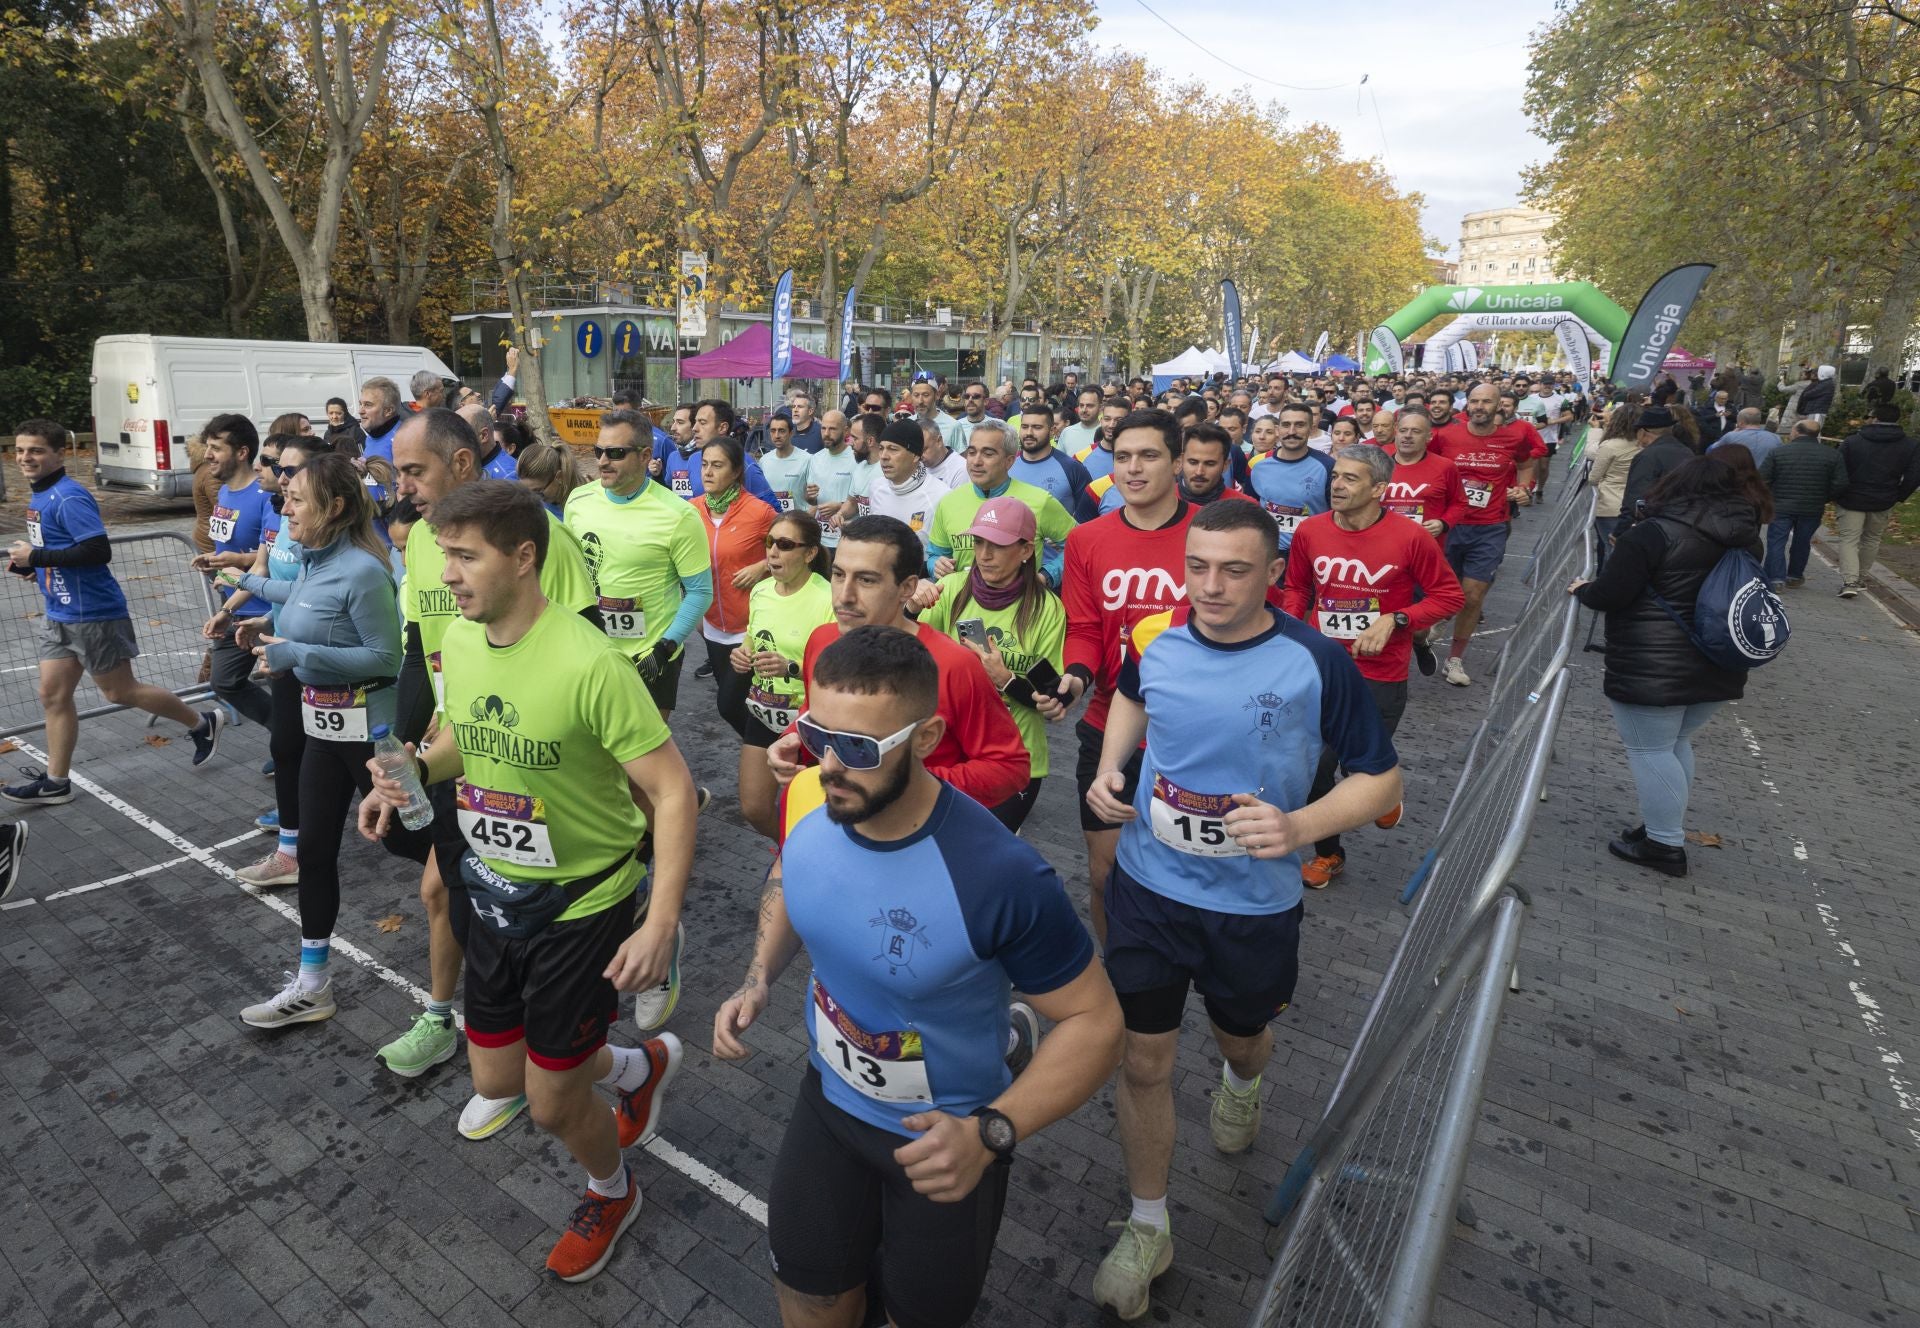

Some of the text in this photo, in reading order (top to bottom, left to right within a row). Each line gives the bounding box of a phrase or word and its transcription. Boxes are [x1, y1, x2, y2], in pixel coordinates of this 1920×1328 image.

[1486, 293, 1562, 310] Unicaja
[778, 292, 790, 359] IVECO
[1477, 316, 1489, 325] El
[1492, 316, 1518, 326] Norte
[1520, 317, 1530, 325] de
[1628, 304, 1681, 380] Unicaja
[567, 419, 573, 428] LA
[1467, 489, 1484, 502] 23
[212, 519, 227, 535] 276
[1275, 515, 1293, 527] 21
[1314, 556, 1393, 585] gmv
[1102, 567, 1187, 611] gmv
[1327, 614, 1370, 631] 413
[314, 710, 344, 731] 59
[753, 704, 790, 727] 618
[450, 719, 561, 765] NTREPINARES
[474, 789, 483, 802] 9ª
[509, 794, 516, 802] DE
[1168, 784, 1177, 797] 9ª
[1178, 789, 1208, 801] CARRERA
[484, 798, 516, 810] EMPRESAS
[1178, 796, 1218, 810] EMPRESAS
[471, 816, 536, 852] 452
[1174, 815, 1225, 845] 15
[835, 1040, 886, 1087] 13
